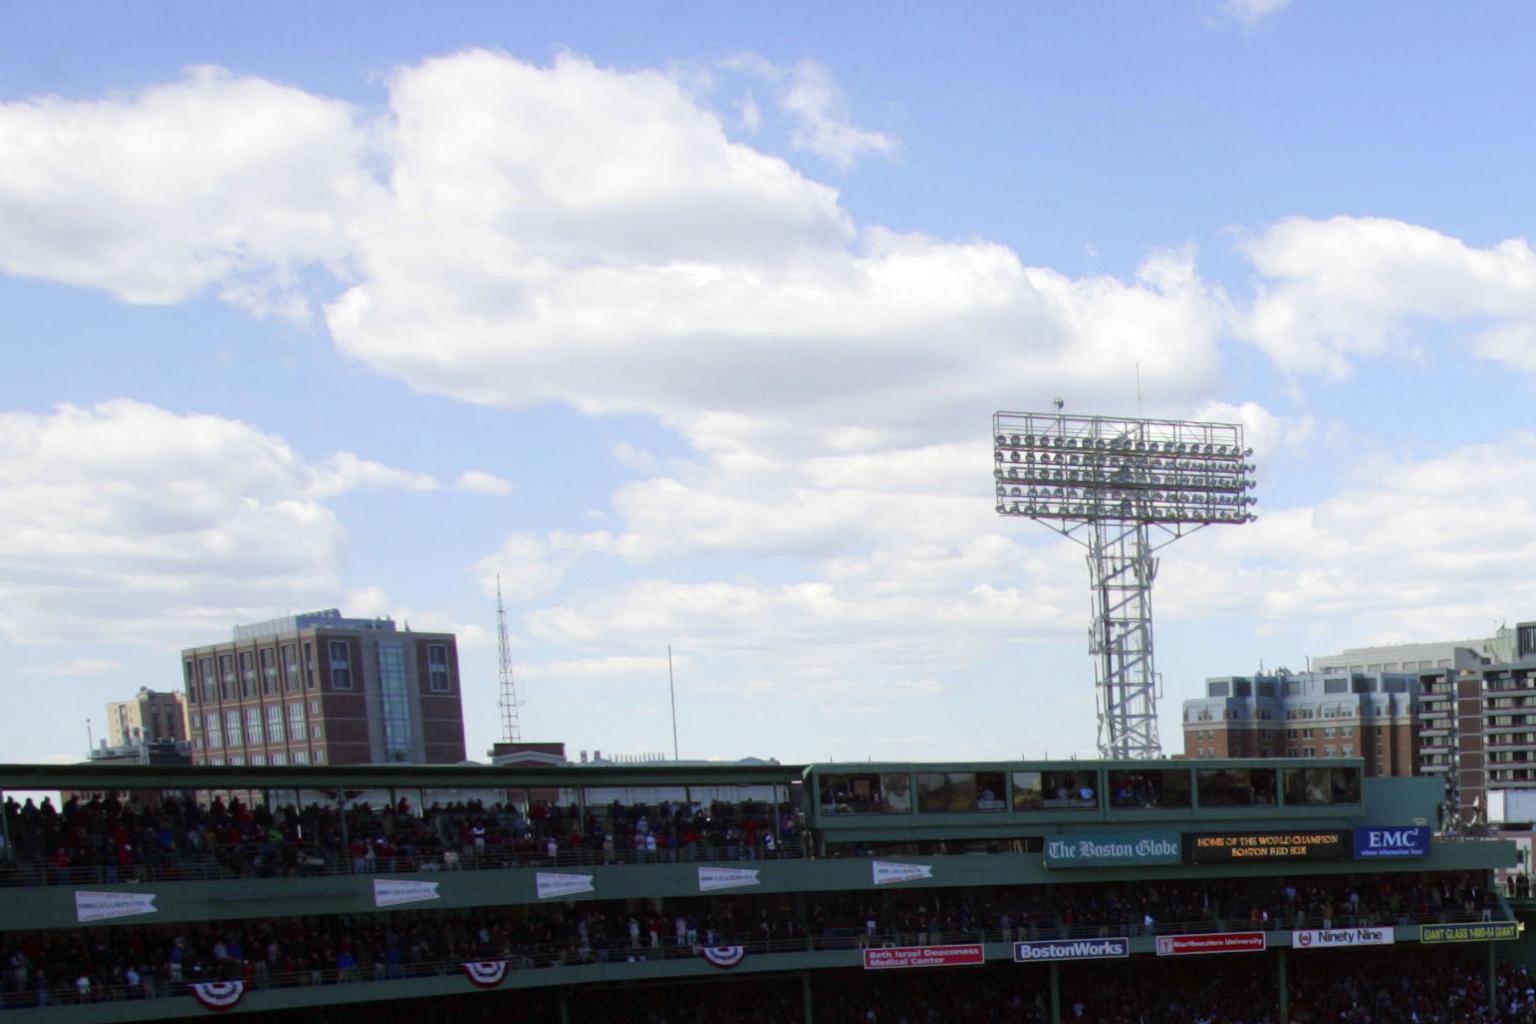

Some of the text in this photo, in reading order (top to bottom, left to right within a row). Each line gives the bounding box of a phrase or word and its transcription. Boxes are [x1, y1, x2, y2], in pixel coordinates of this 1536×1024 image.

[1049, 838, 1178, 859] The Boston Globe
[1239, 836, 1257, 846] THE
[1231, 846, 1307, 857] BOSTON RED SOX
[1318, 930, 1355, 944] Ninety
[1357, 928, 1383, 941] Nine
[1020, 943, 1123, 959] BostonWorks
